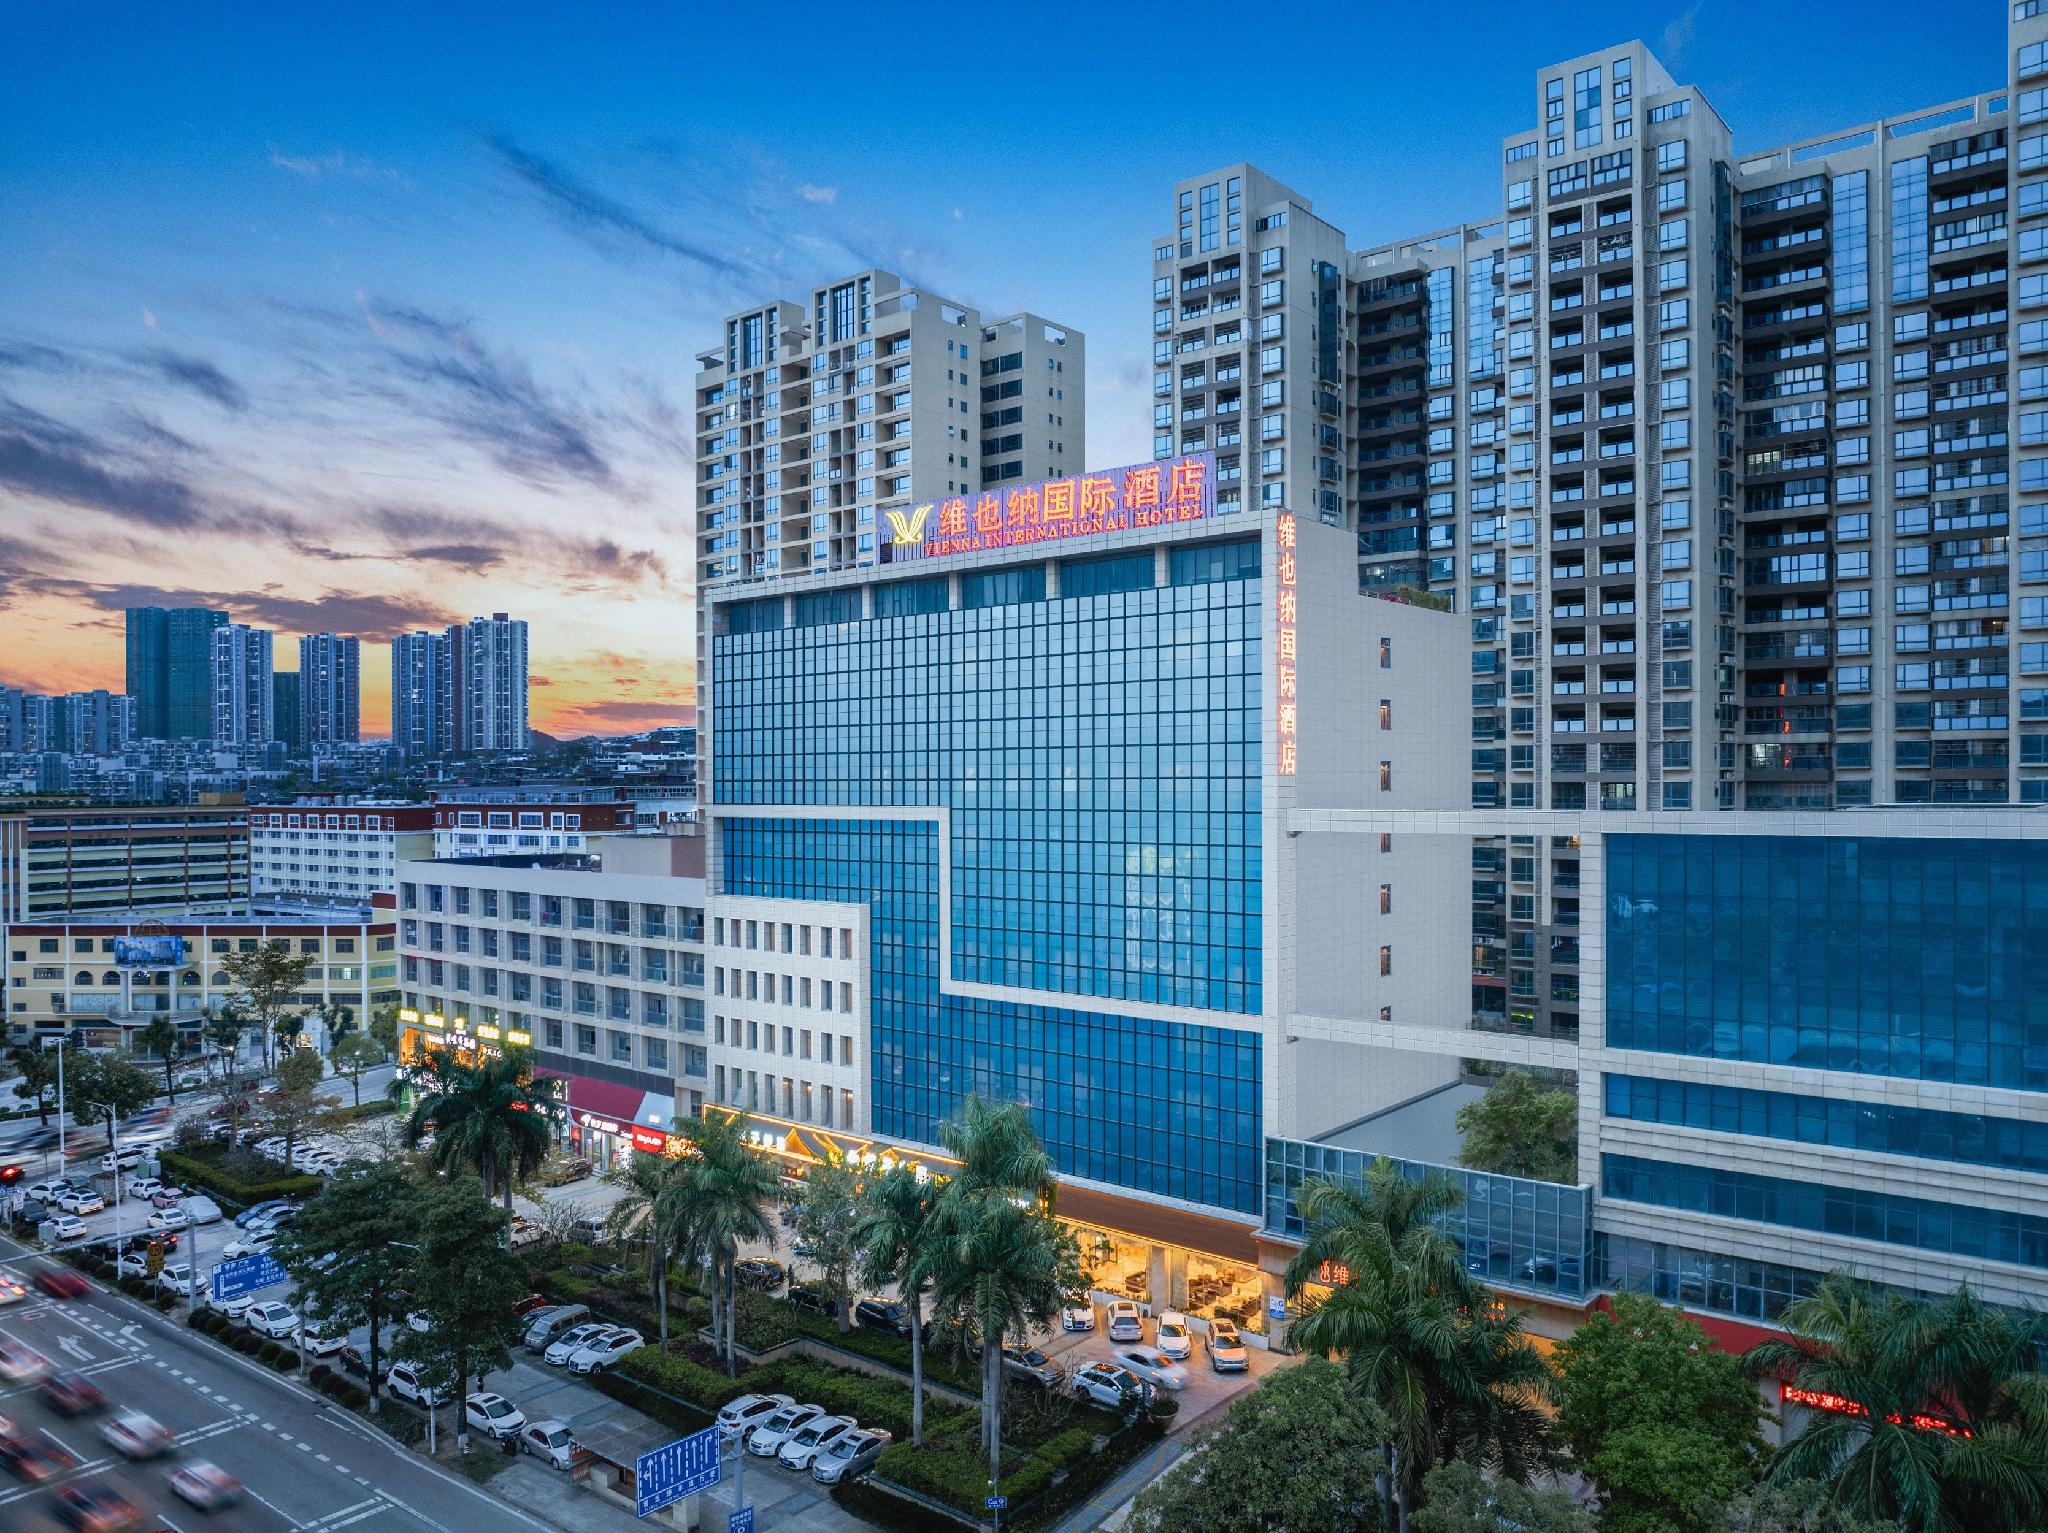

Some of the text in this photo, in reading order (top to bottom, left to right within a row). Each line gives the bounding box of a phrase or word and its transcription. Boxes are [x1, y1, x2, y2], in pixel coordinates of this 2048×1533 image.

[924, 503, 1204, 557] VIENNA INTERNATIONAL HOTEL
[939, 459, 1206, 536] 维也纳国际酒店
[1278, 513, 1297, 775] 维也纳国际酒店
